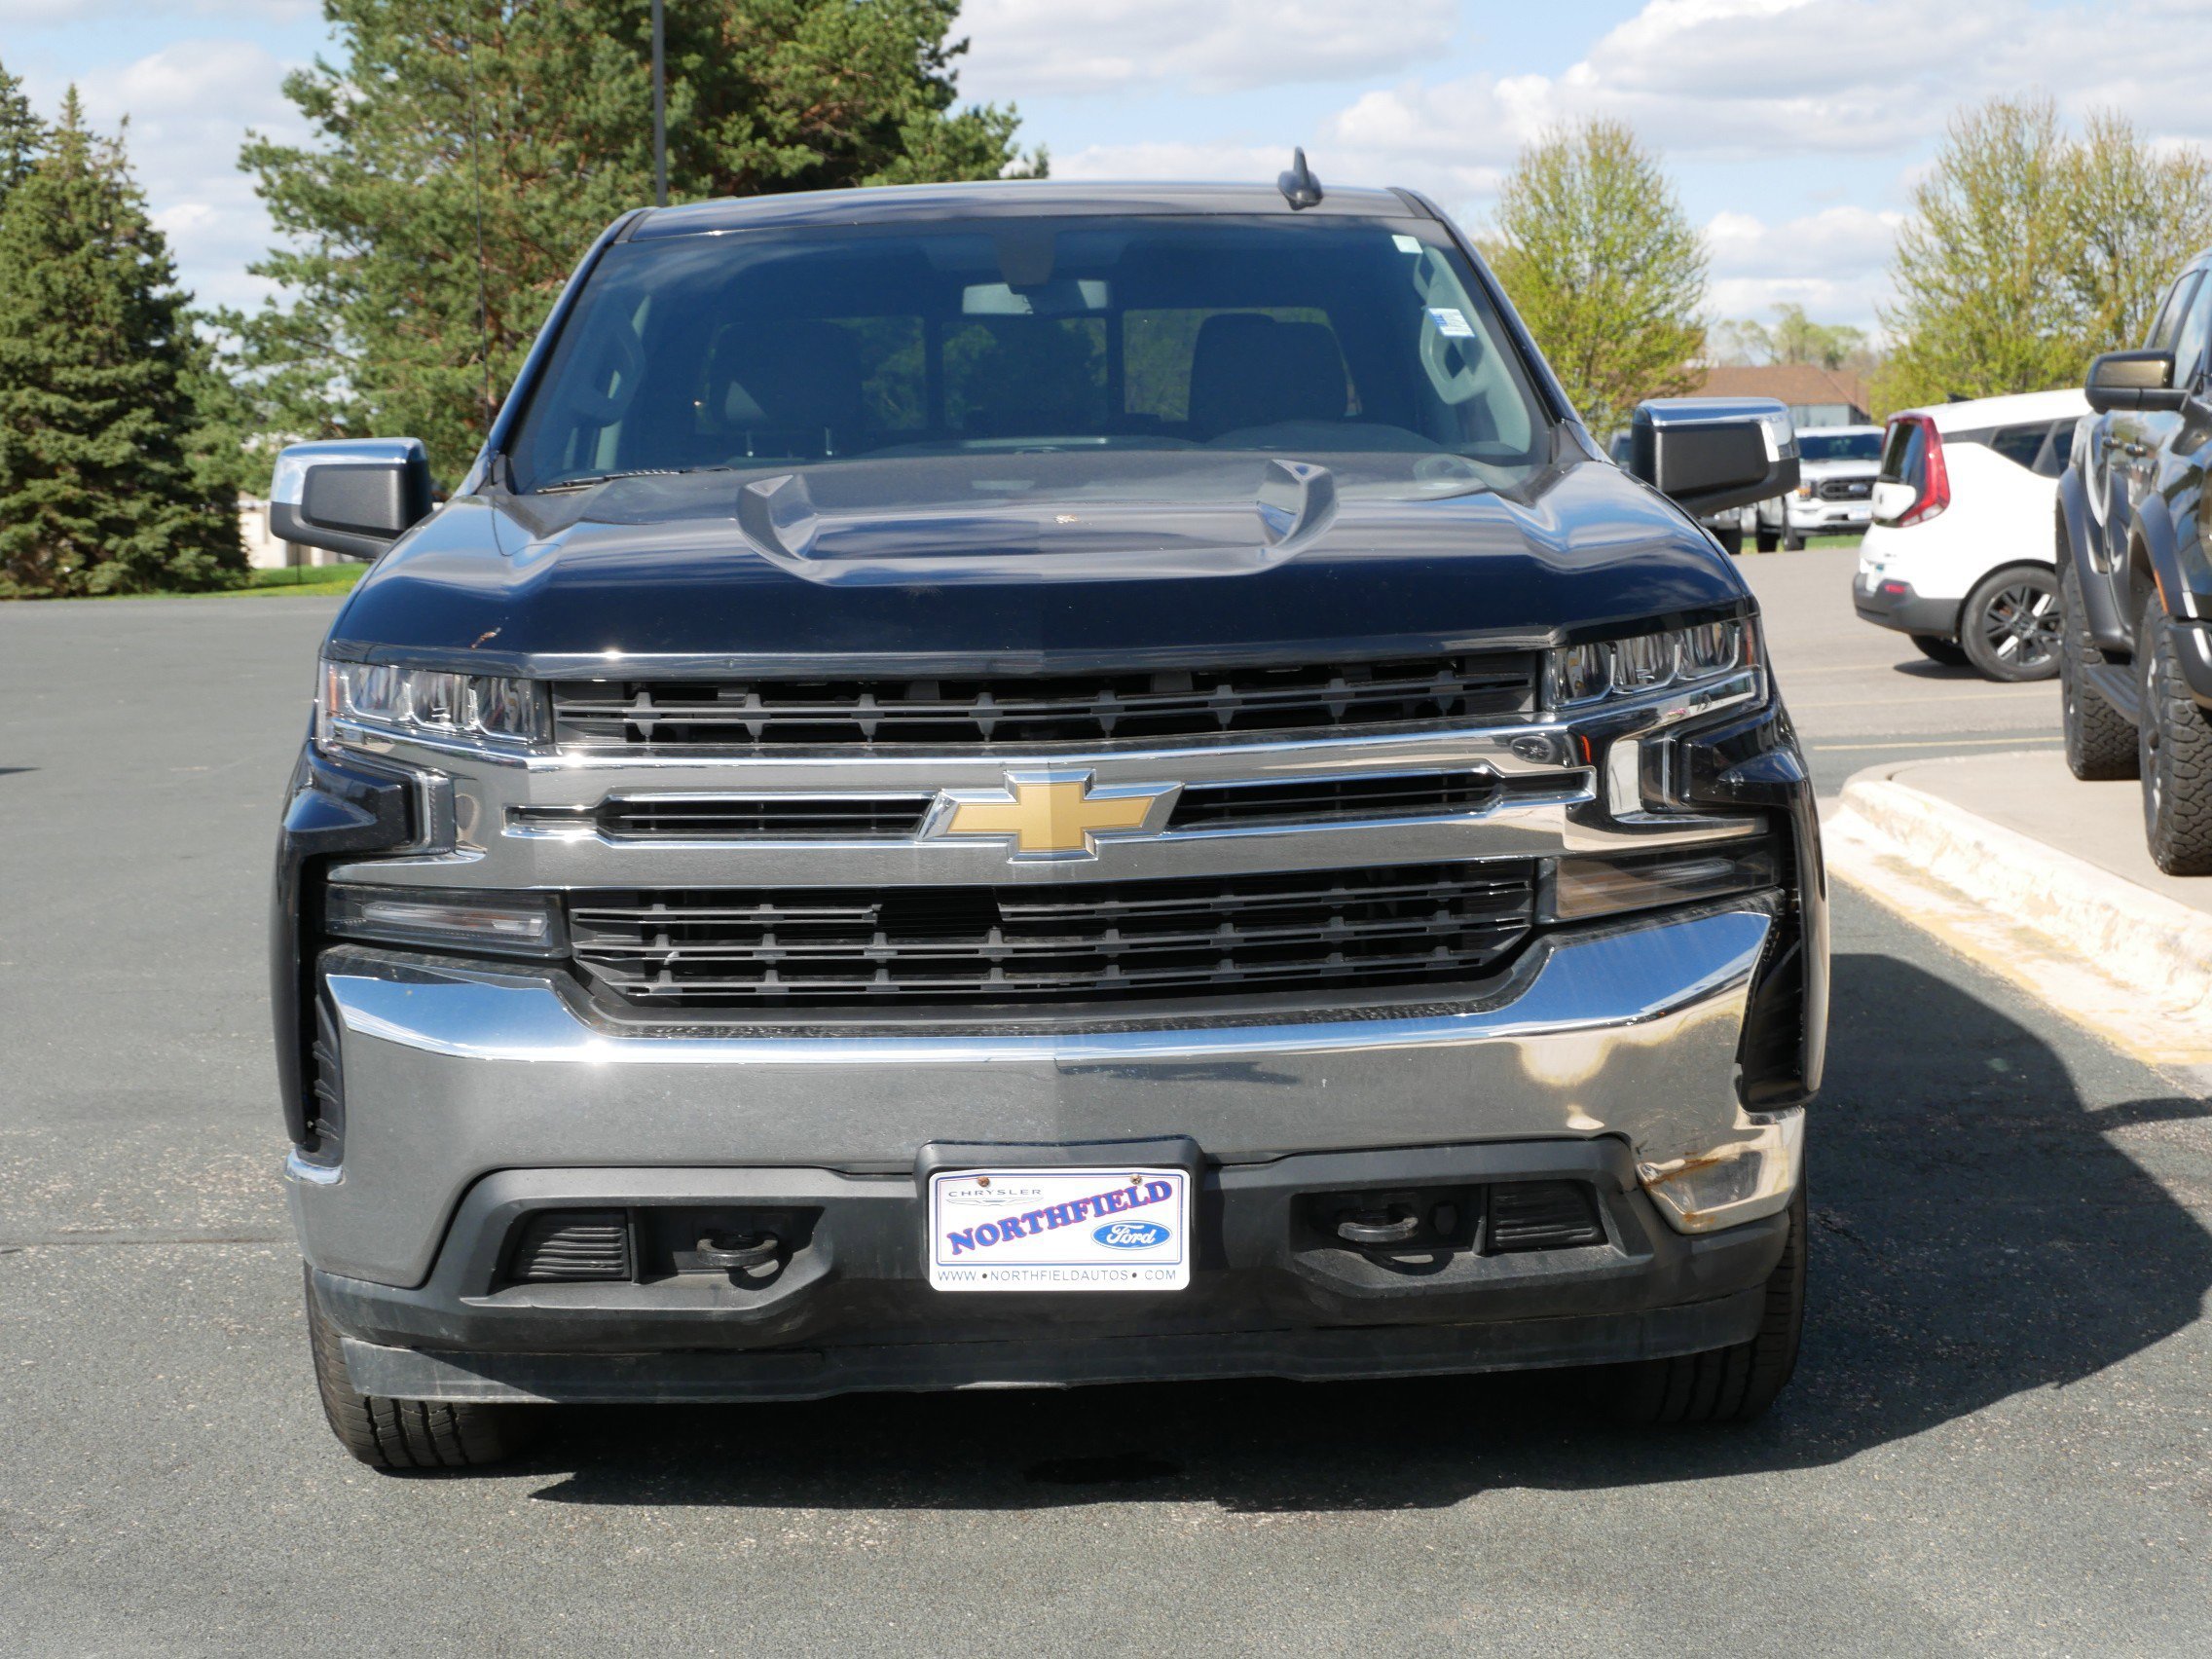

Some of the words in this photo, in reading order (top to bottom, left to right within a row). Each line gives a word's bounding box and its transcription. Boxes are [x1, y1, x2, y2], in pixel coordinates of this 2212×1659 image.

[948, 1189, 1042, 1198] CHRYSLER
[947, 1180, 1173, 1255] NORTHFIELD
[1106, 1223, 1157, 1244] Ford
